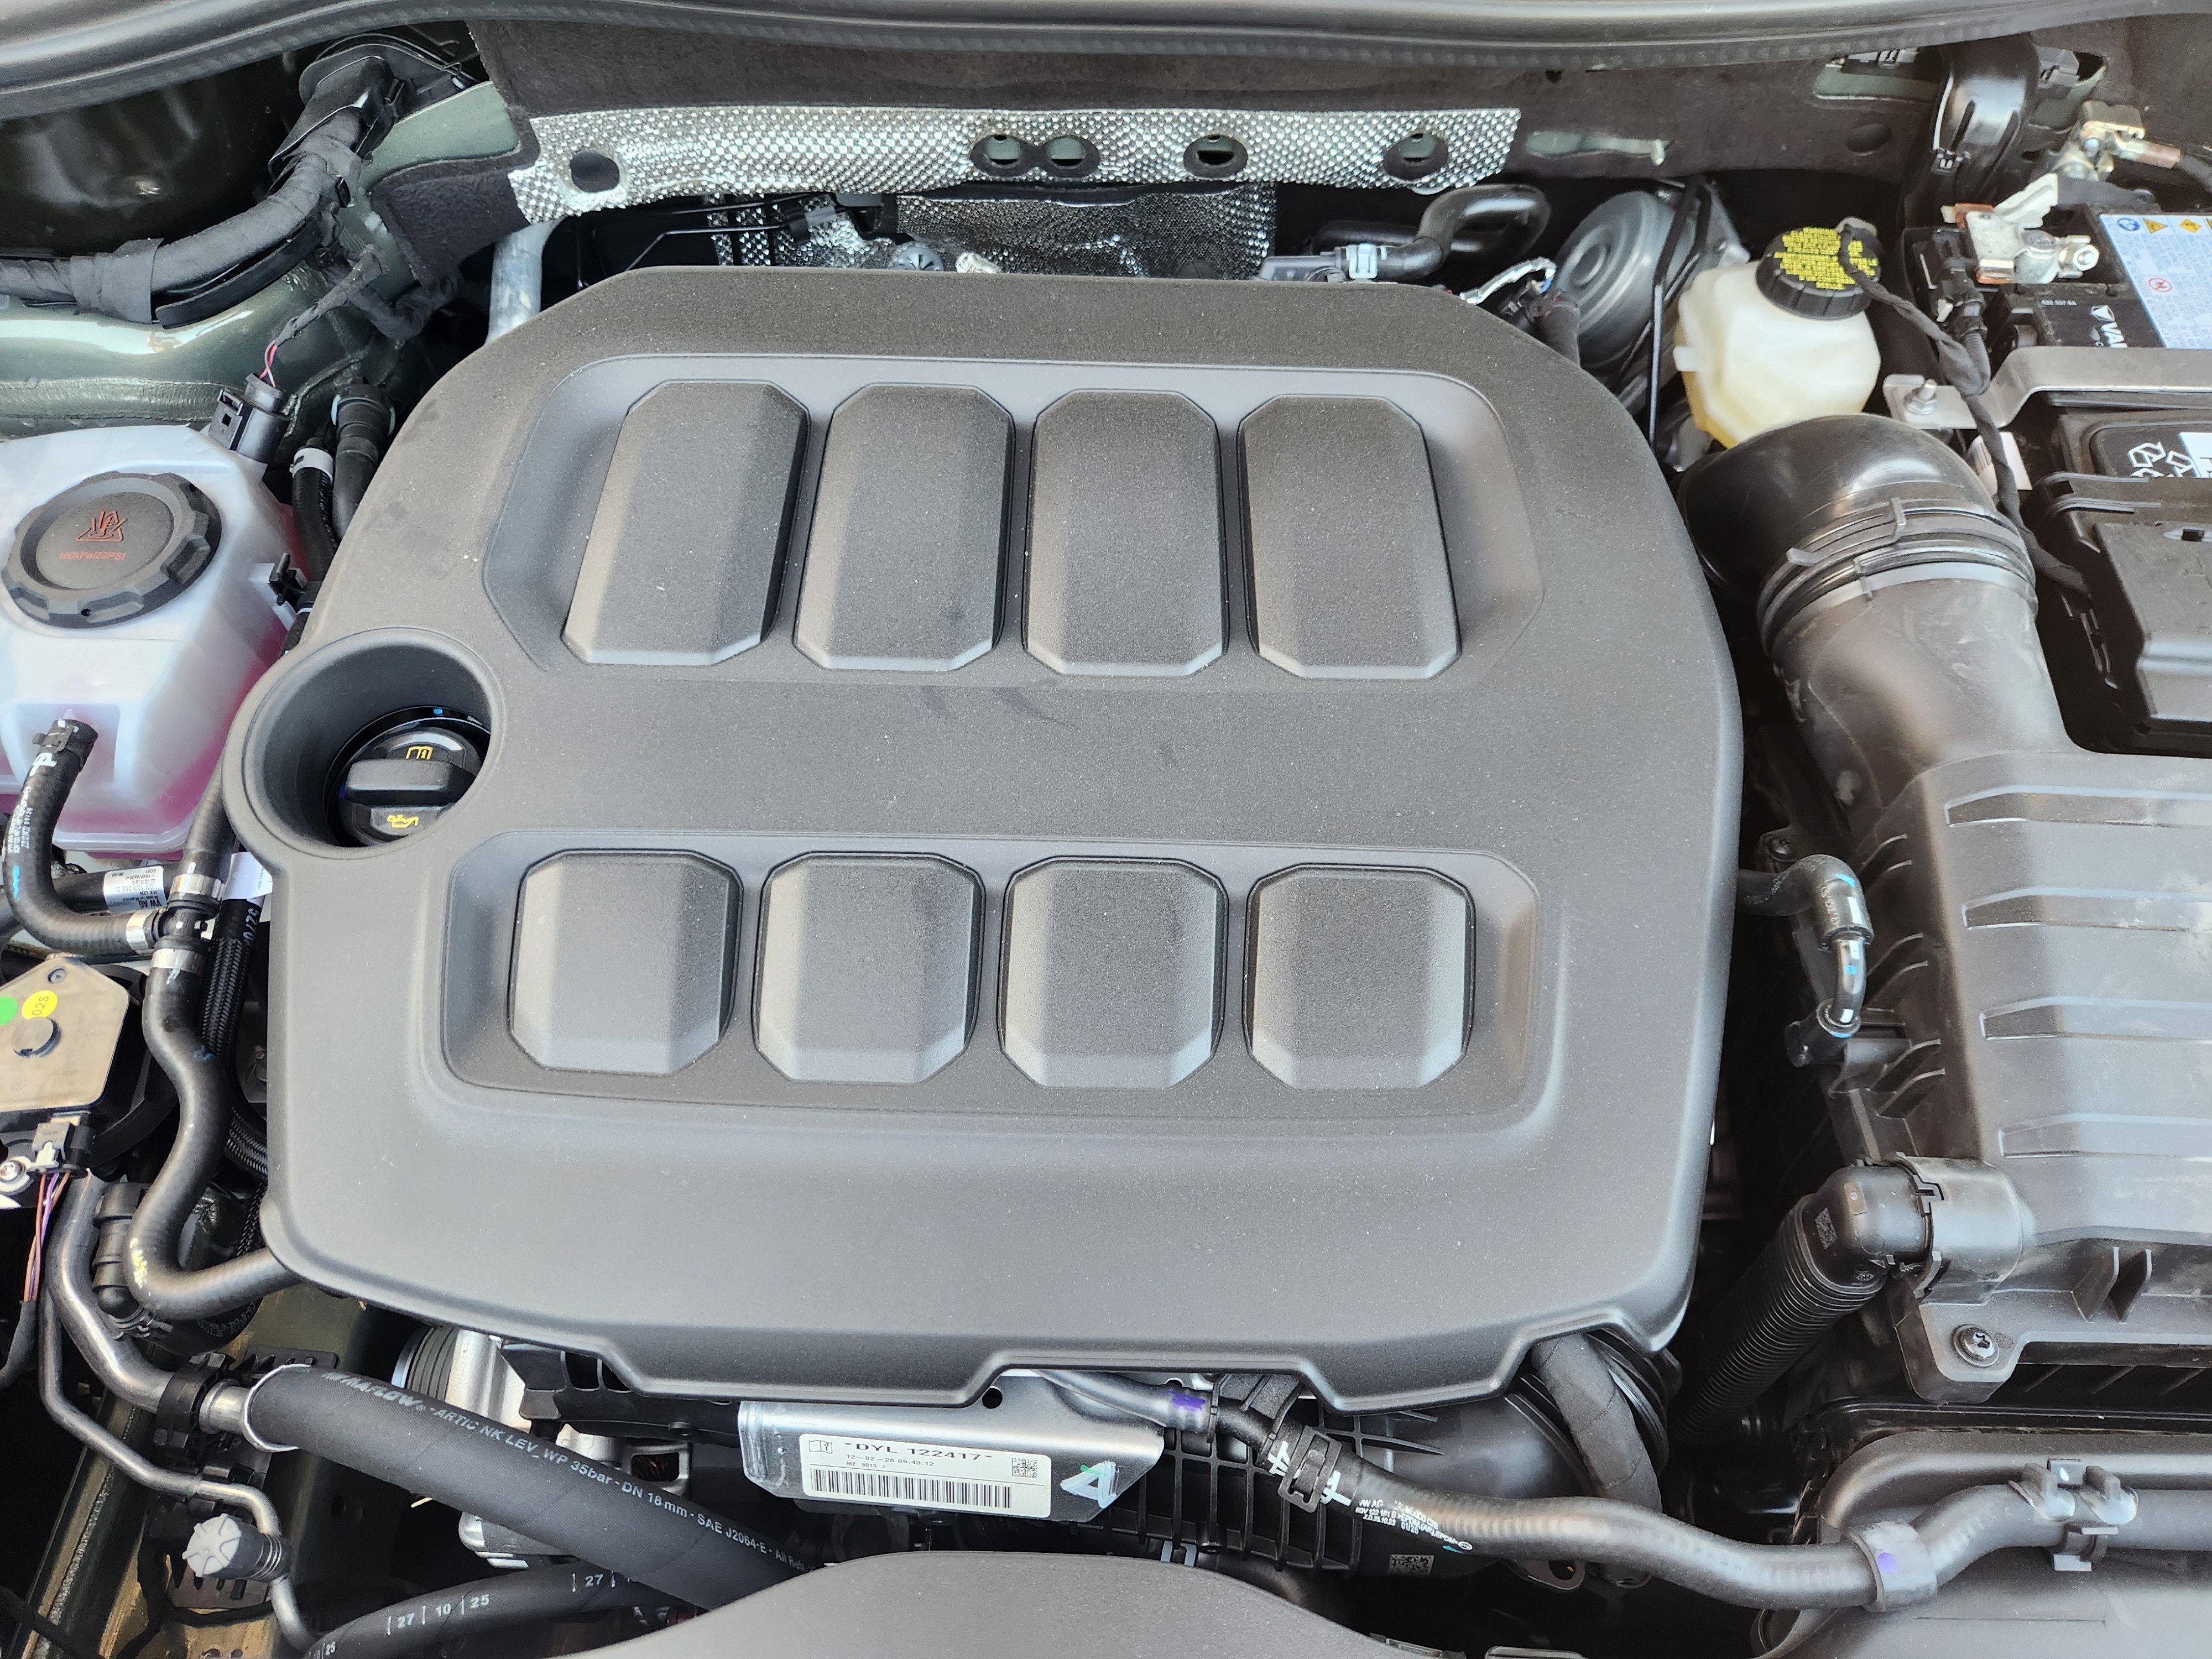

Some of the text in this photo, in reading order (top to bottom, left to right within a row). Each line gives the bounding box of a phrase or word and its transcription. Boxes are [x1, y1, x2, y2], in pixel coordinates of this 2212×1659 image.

[150, 899, 162, 907] VW
[544, 1448, 568, 1464] WP
[571, 1460, 613, 1485] 35bar
[622, 1481, 644, 1499] DN
[697, 1513, 723, 1534] SAE
[1359, 1499, 1371, 1507] VW
[585, 1574, 604, 1588] 27
[397, 1594, 490, 1628] 27 10 25
